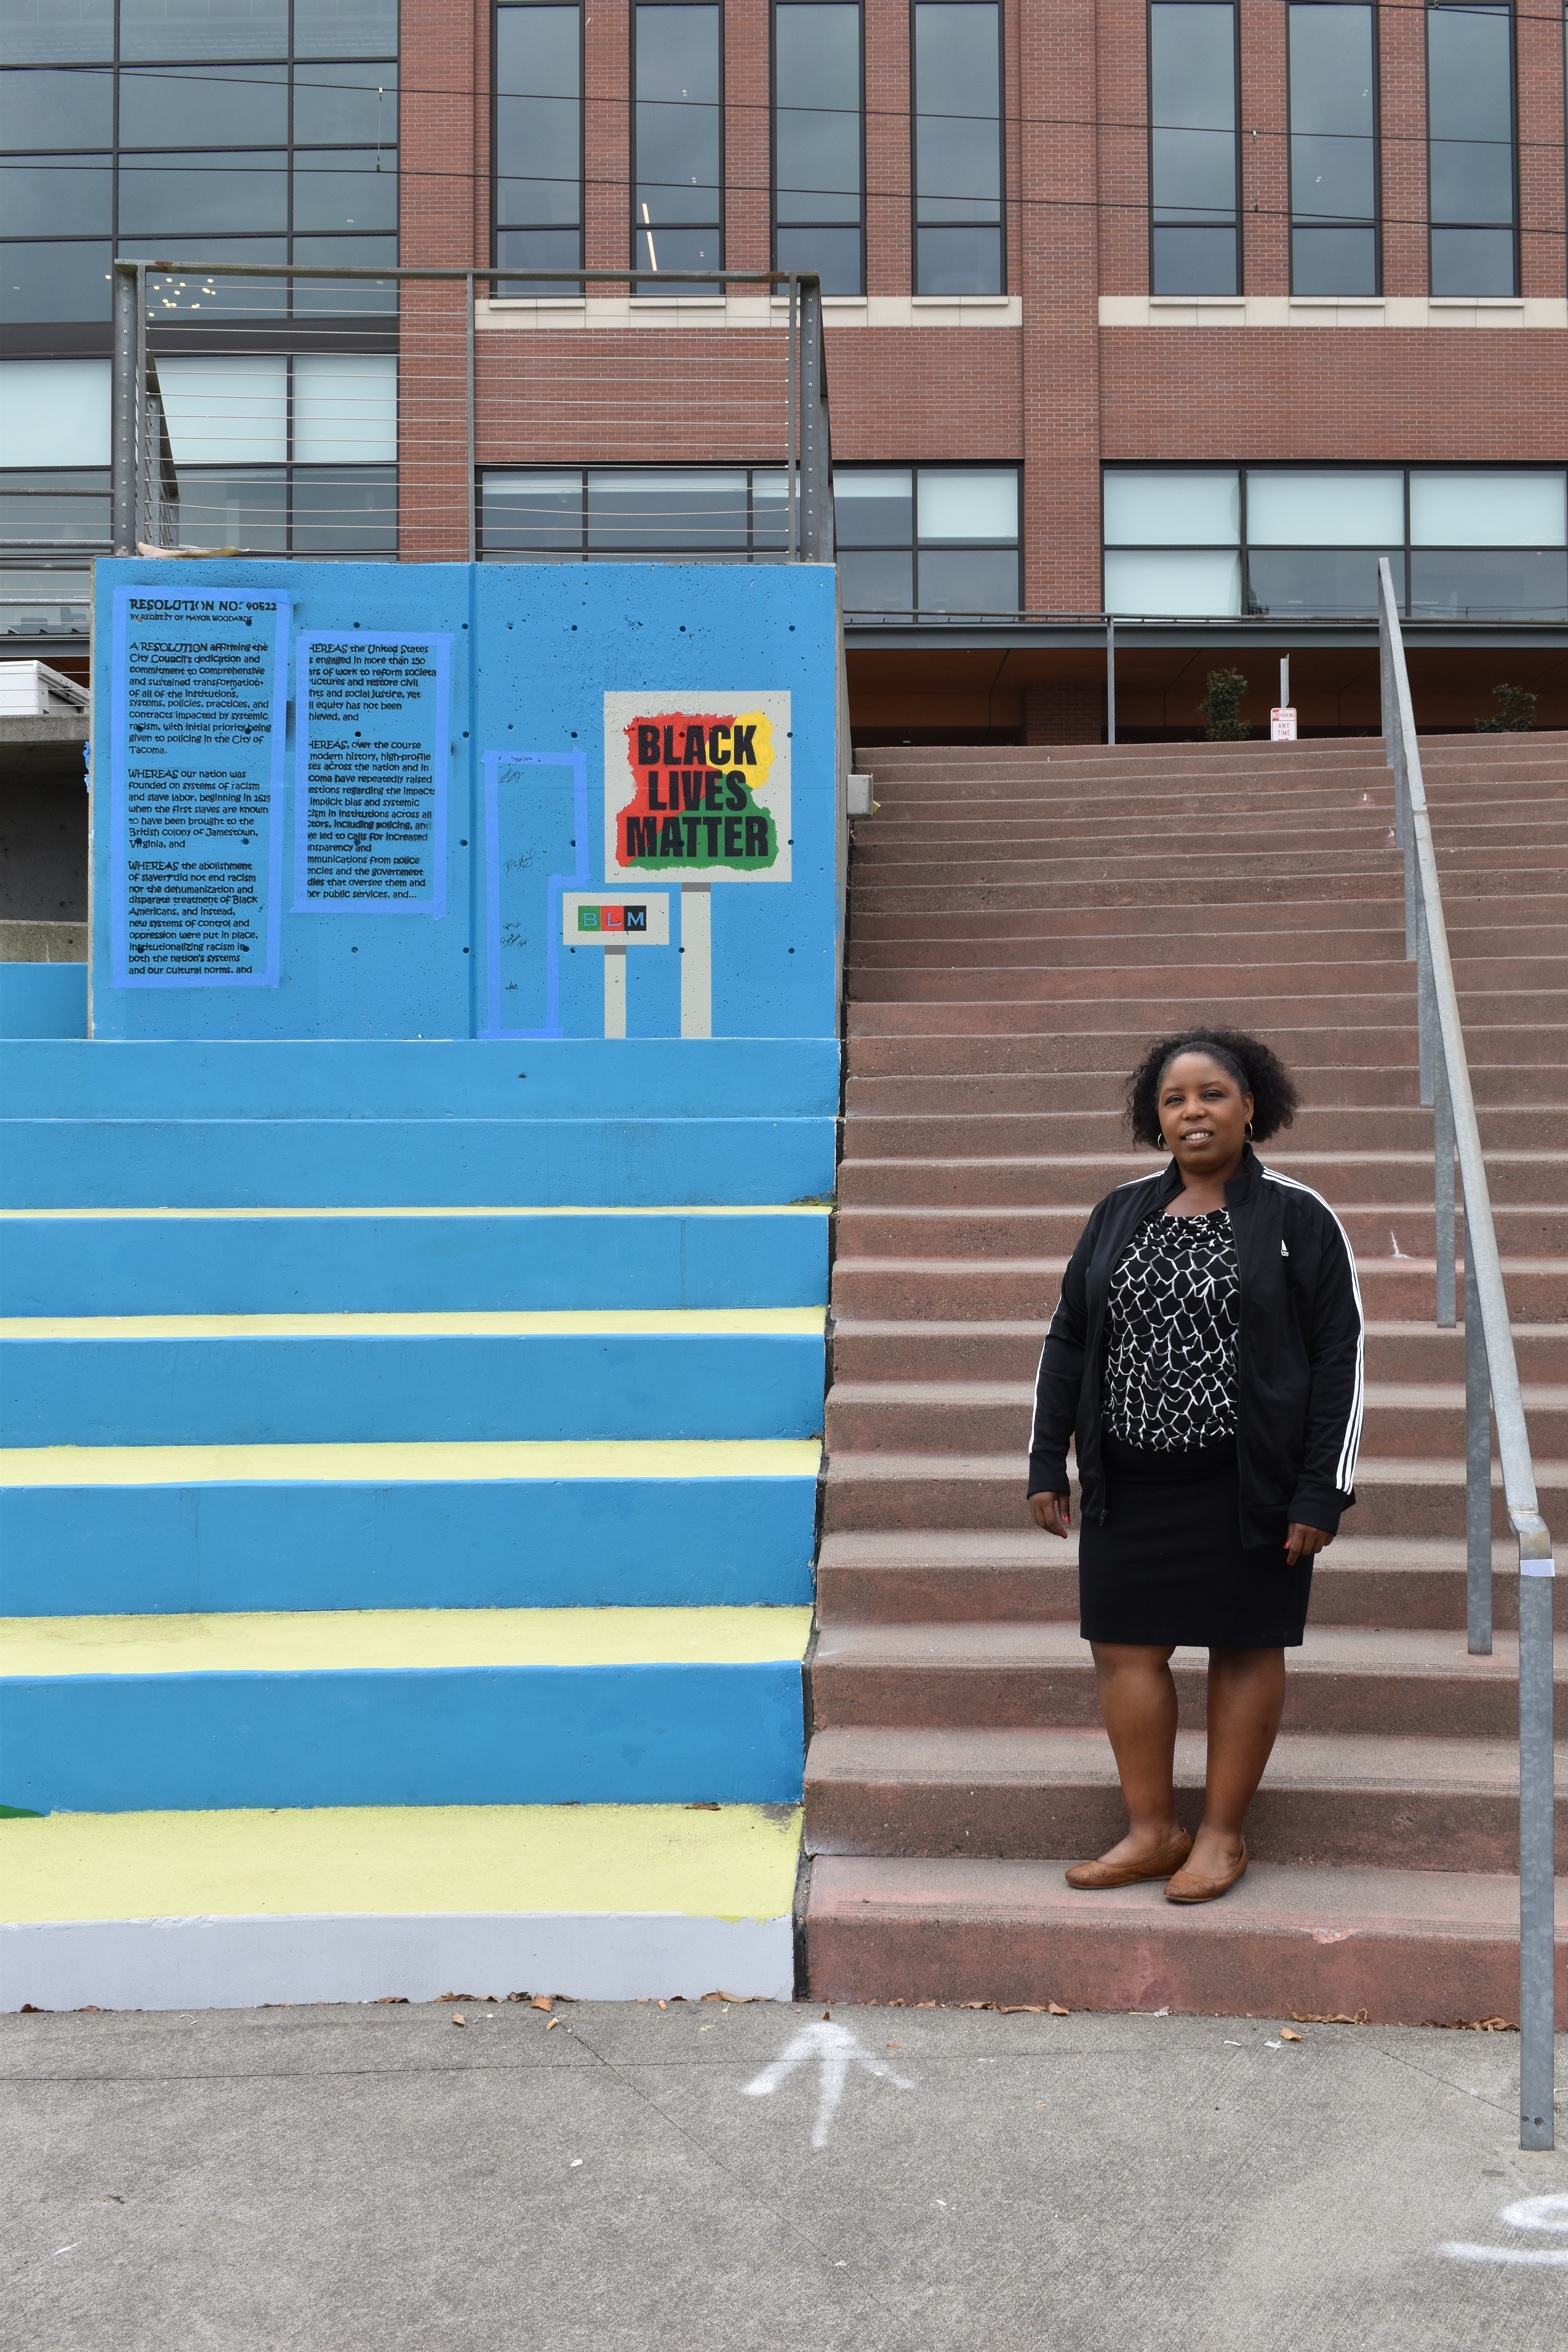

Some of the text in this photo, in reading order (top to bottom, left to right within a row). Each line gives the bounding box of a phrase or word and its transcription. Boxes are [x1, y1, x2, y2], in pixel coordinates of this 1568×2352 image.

[129, 599, 214, 611] RESOLUTION
[129, 641, 269, 653] A RESOLUTION affirming the
[349, 644, 429, 655] the United States
[129, 653, 149, 663] City
[194, 653, 241, 665] dedication
[243, 655, 260, 663] and
[315, 655, 426, 665] engaged in more than 150
[129, 666, 185, 675] commitment
[199, 666, 265, 675] comprehensive
[129, 677, 260, 687] and sustained transformation
[129, 689, 238, 699] of all of the institutions,
[326, 689, 343, 698] and
[345, 689, 370, 699] social
[407, 690, 421, 699] yet
[129, 699, 269, 709] systems, policies, practices, and
[129, 711, 269, 720] contracts impacted by systemic
[163, 722, 272, 733] with initial priority being
[129, 733, 152, 742] given
[167, 734, 202, 744] policing
[204, 734, 212, 743] in
[214, 735, 230, 743] the
[232, 735, 251, 744] City
[253, 735, 264, 744] of
[638, 724, 757, 766] BLACK
[129, 746, 167, 755] Tacoma.
[310, 751, 431, 762] modern history, high-profile
[127, 769, 179, 780] WHEREAS
[199, 769, 227, 779] nation
[128, 781, 167, 790] founded
[218, 782, 230, 791] of
[231, 782, 260, 790] racism
[649, 770, 747, 812] LIVES
[129, 793, 271, 803] and slave labor, beginning in 1619
[310, 797, 420, 807] implicit bias and systemic
[129, 805, 152, 813] when
[154, 805, 170, 813] the
[172, 805, 192, 814] first
[194, 806, 220, 814] slaves
[239, 806, 269, 814] known
[141, 817, 163, 825] have
[164, 817, 186, 825] been
[188, 817, 225, 826] brought
[238, 817, 255, 826] the
[129, 828, 160, 837] British
[162, 828, 191, 837] colony
[205, 828, 258, 837] Jamestown,
[626, 815, 768, 858] MATTER
[169, 840, 185, 848] and
[128, 860, 252, 871] WHEREAS the abolishment
[128, 873, 140, 882] of
[141, 873, 172, 882] slavery
[173, 873, 188, 882] did
[208, 873, 225, 882] end
[227, 873, 256, 882] racism
[129, 885, 254, 894] nor the dehumanization and
[323, 889, 350, 899] public
[352, 890, 390, 899] services,
[129, 895, 171, 905] disparate
[220, 895, 232, 904] of
[232, 895, 258, 905] Black
[128, 907, 235, 916] Americans, and instead,
[149, 920, 183, 928] systems
[185, 919, 197, 928] of
[197, 919, 231, 928] control
[233, 919, 250, 927] and
[129, 931, 177, 940] oppression
[203, 932, 219, 940] put
[221, 930, 229, 939] in
[232, 931, 258, 940] place,
[129, 942, 235, 953] institutionalizing racism
[129, 954, 150, 963] both
[152, 954, 168, 963] the
[207, 955, 241, 963] systems
[129, 966, 145, 975] and
[166, 966, 201, 975] cultural
[236, 965, 252, 974] and
